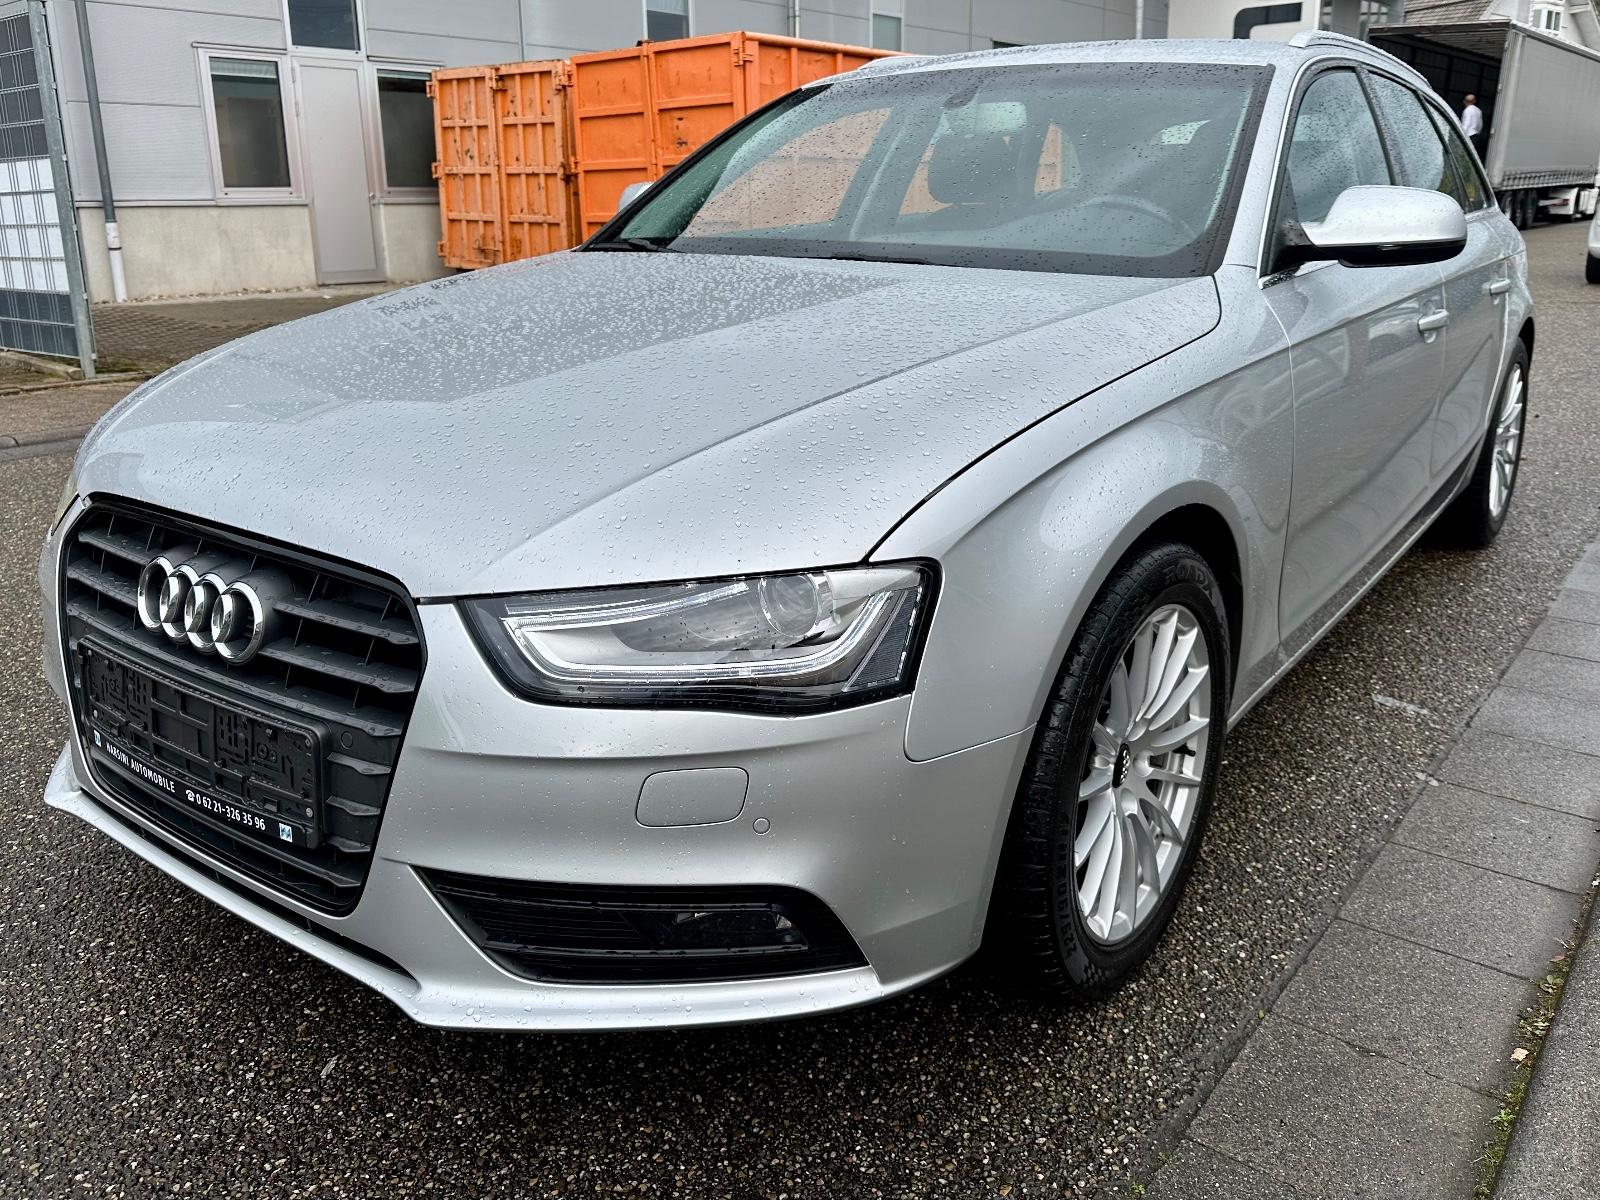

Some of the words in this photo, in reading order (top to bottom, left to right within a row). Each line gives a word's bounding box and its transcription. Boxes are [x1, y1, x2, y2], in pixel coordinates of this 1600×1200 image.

[130, 758, 176, 793] AUTOMOBILE
[196, 793, 202, 805] 0
[202, 796, 213, 810] 62
[213, 800, 241, 821] 21-326
[242, 812, 253, 826] 35
[254, 817, 266, 831] 96
